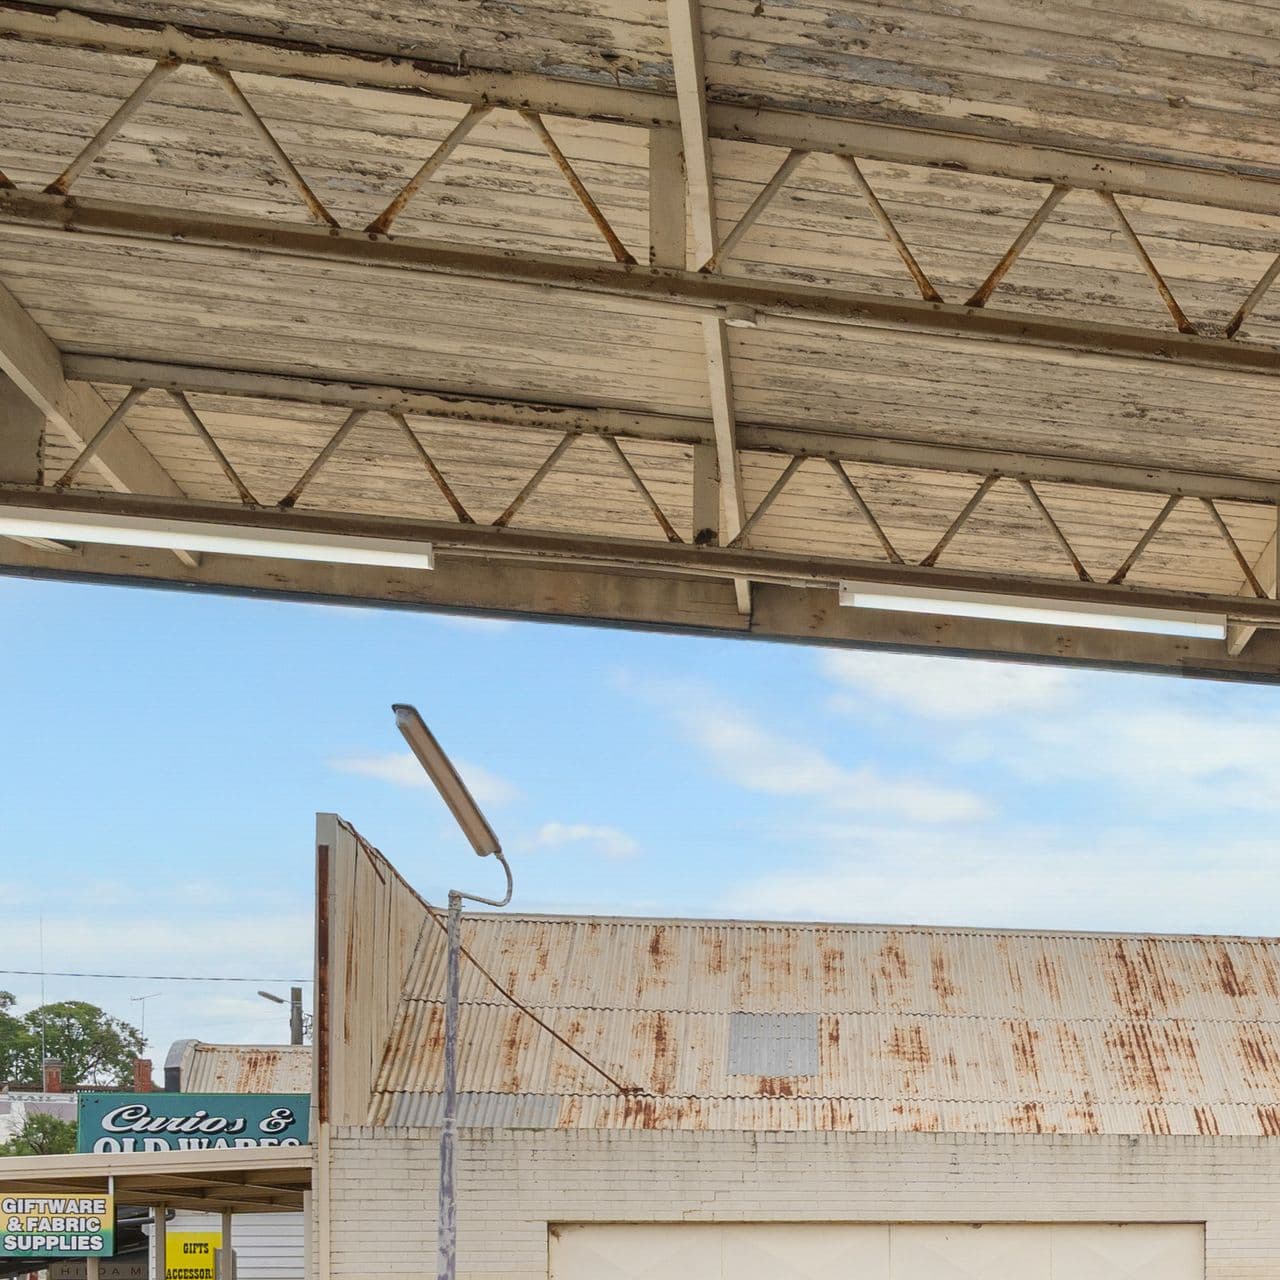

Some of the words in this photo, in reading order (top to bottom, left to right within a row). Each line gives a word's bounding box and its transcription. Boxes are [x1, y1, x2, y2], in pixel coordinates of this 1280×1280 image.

[101, 1104, 245, 1133] Curios
[258, 1108, 294, 1133] &
[2, 1199, 106, 1214] GIFTWARE
[7, 1218, 24, 1233] &
[26, 1217, 101, 1233] FABRIC
[4, 1235, 103, 1251] SUPPLIES
[183, 1243, 209, 1254] GIFTS
